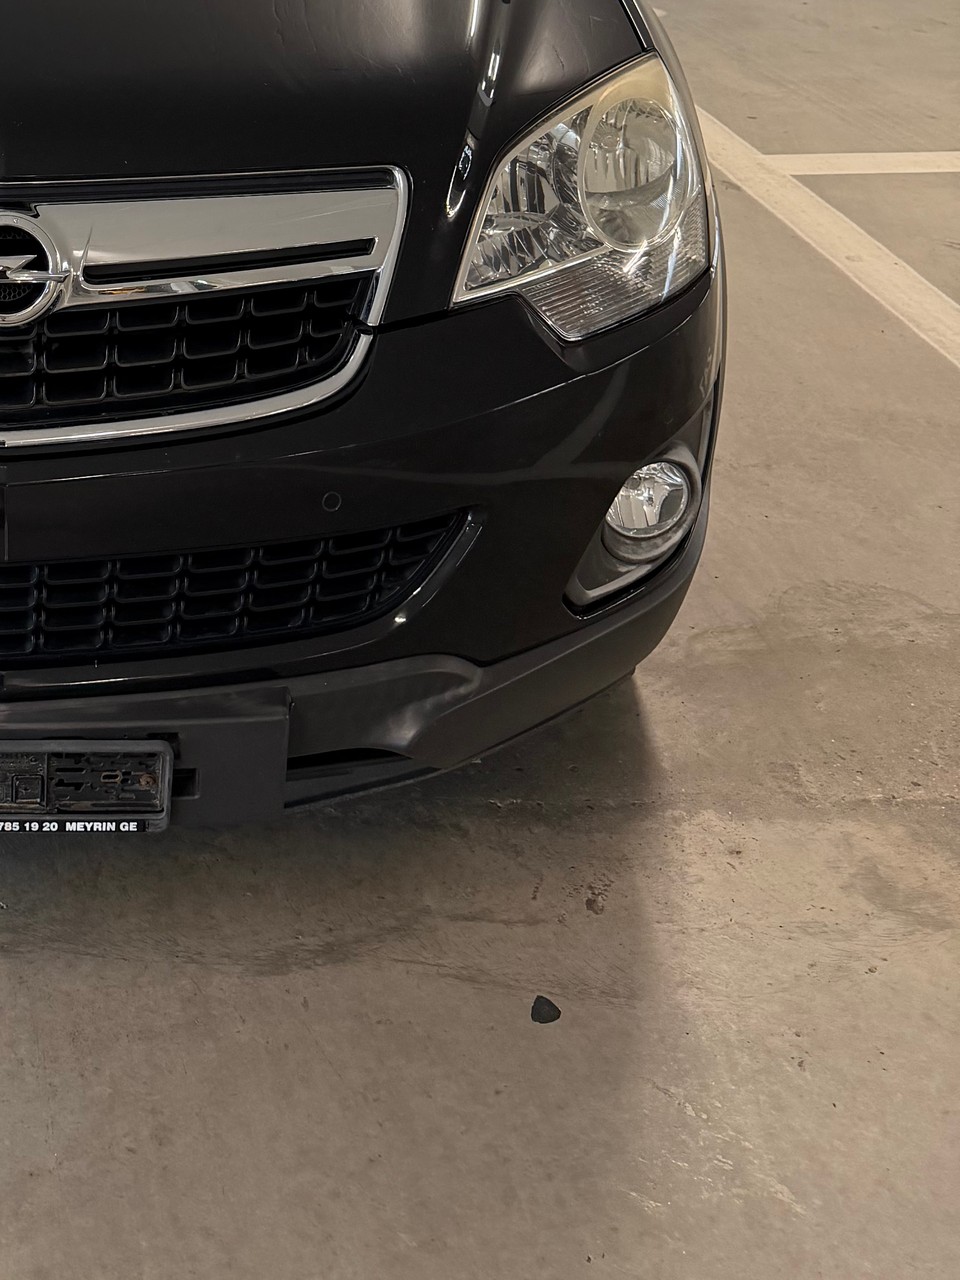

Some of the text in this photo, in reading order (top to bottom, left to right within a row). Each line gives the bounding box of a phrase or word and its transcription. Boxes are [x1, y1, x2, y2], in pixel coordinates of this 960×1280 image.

[24, 821, 39, 831] 19
[42, 821, 59, 831] 20
[65, 821, 116, 831] MEYRIN
[119, 821, 138, 832] GE
